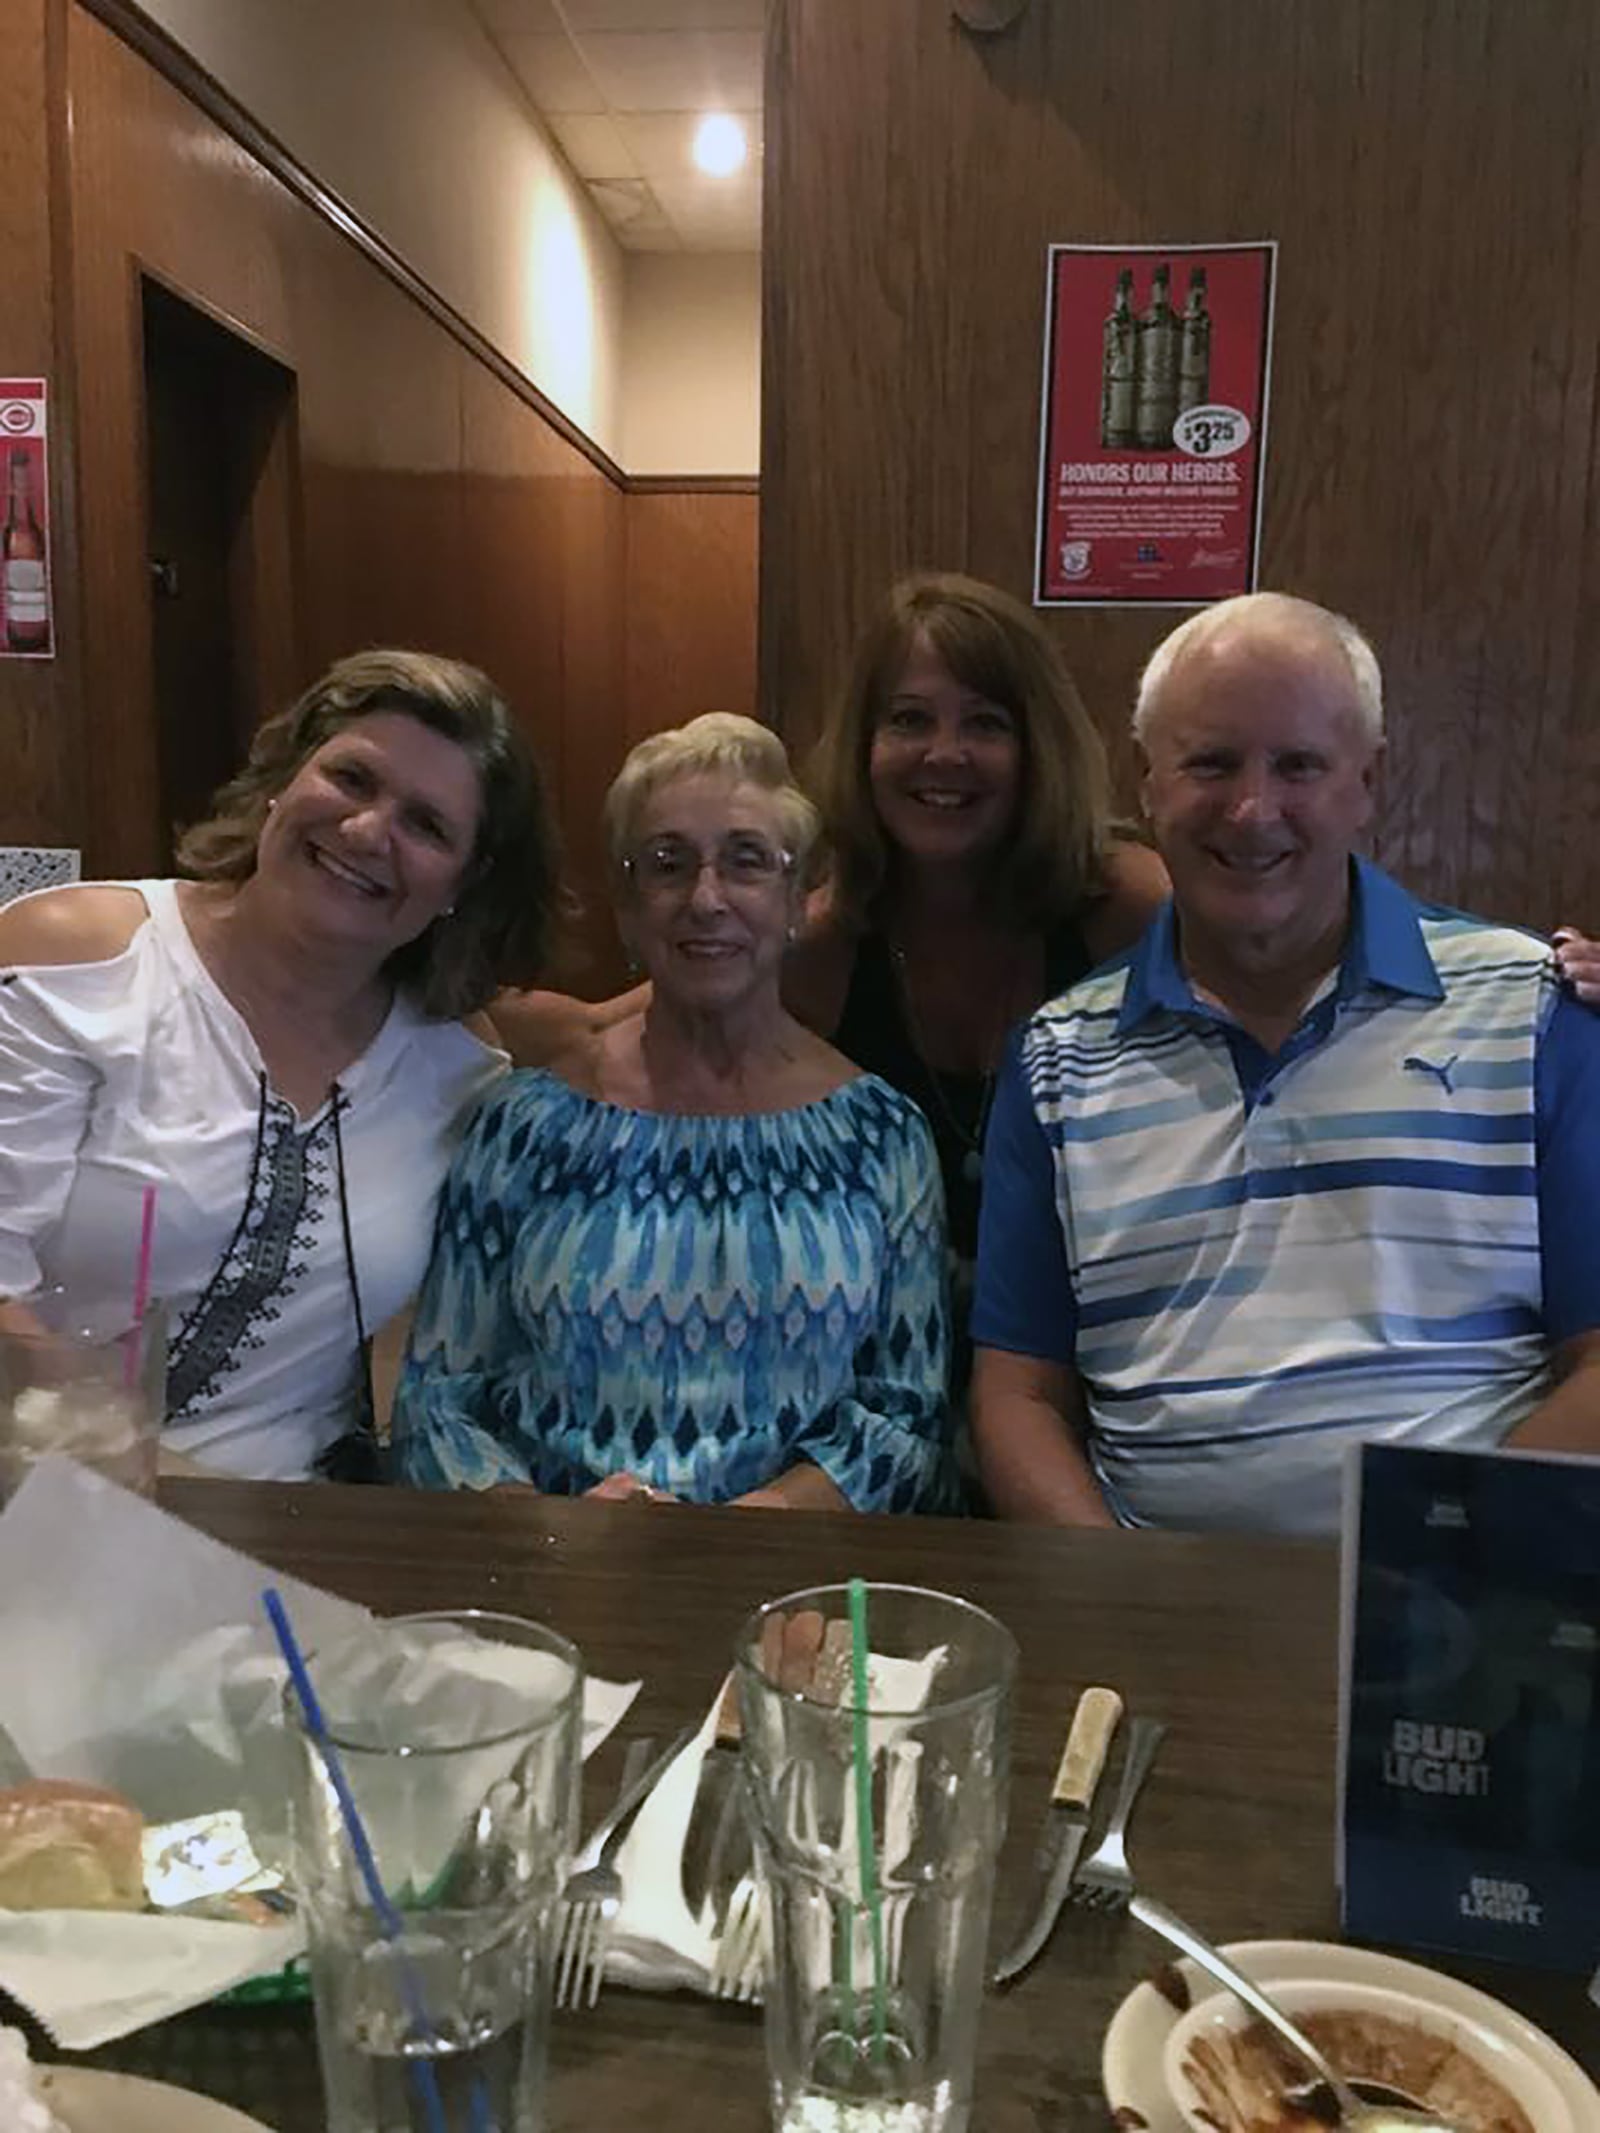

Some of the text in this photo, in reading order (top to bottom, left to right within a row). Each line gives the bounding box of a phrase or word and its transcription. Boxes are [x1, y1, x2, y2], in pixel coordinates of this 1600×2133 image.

[1060, 462, 1130, 482] HONORS
[1132, 462, 1168, 482] OUR
[1393, 1719, 1485, 1762] BUD
[1384, 1750, 1491, 1796] LIGHT
[1471, 1877, 1529, 1903] BUD
[1460, 1893, 1543, 1926] LIGHT
